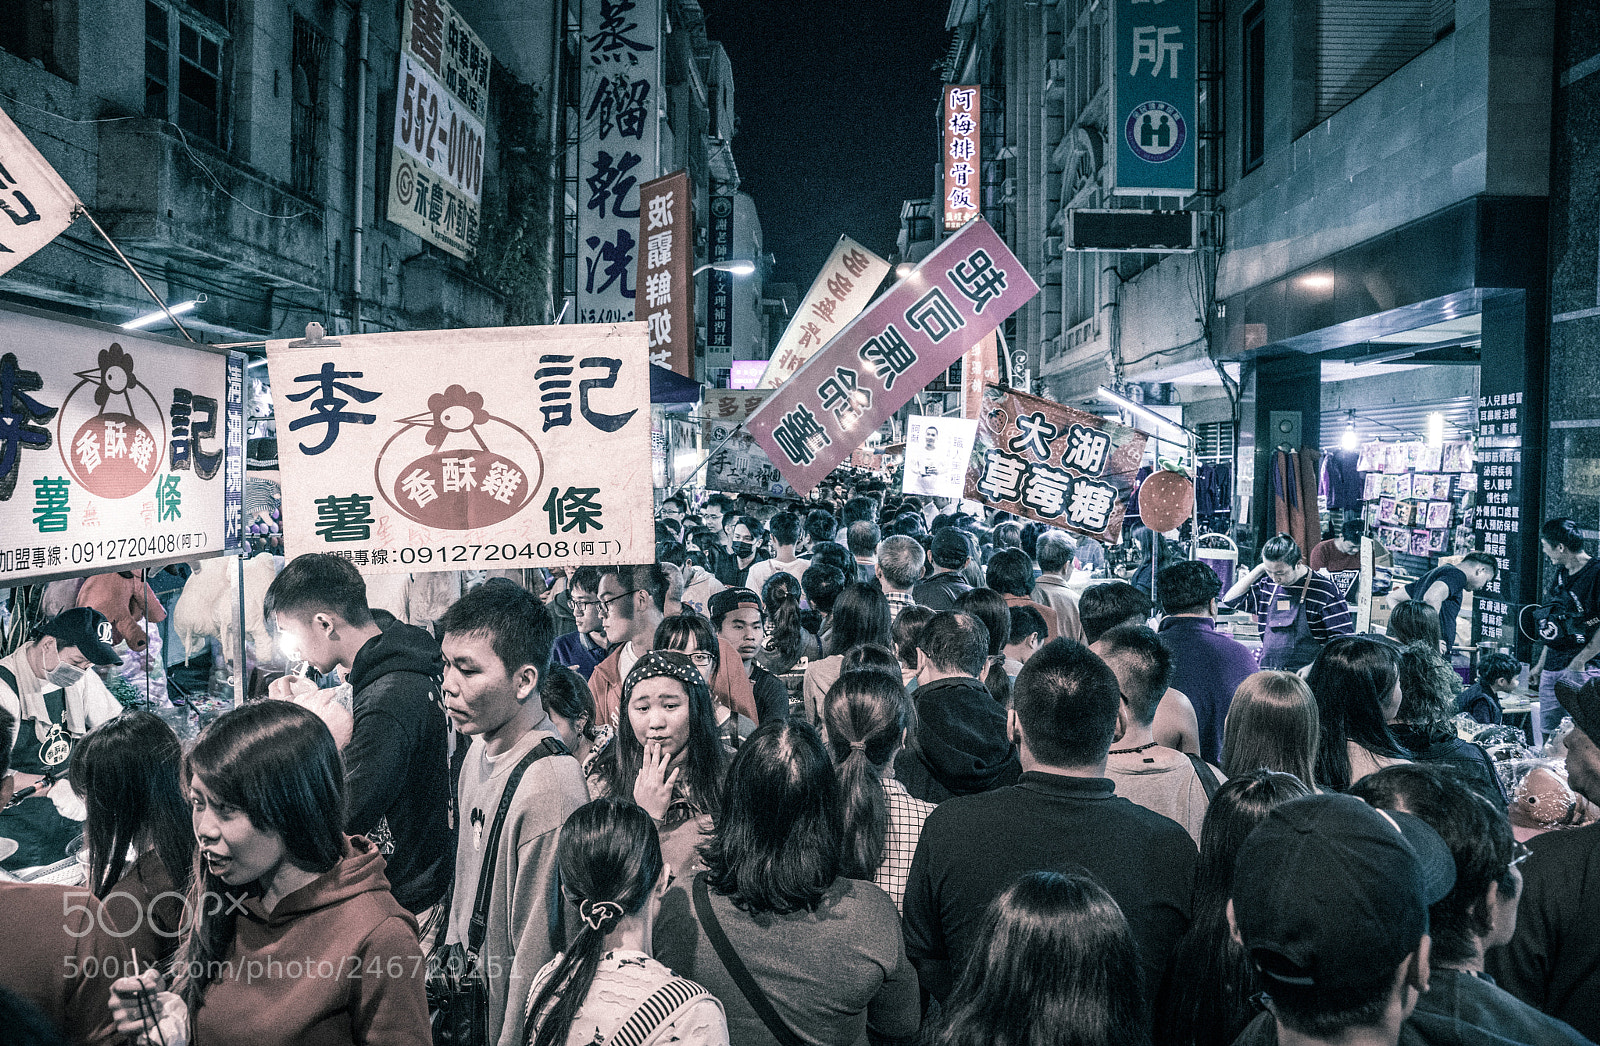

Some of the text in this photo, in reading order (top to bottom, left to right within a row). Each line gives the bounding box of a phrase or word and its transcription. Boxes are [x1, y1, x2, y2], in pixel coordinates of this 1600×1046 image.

[1129, 0, 1184, 79] 所
[401, 72, 483, 196] 552-0006
[947, 87, 978, 210] 阿梅排骨飯
[169, 387, 223, 480] 記
[285, 362, 382, 455] 李
[534, 354, 638, 433] 記
[76, 420, 156, 474] 香酥雞
[1012, 415, 1108, 473] 大湖
[1483, 466, 1513, 477] 泌尿疾病
[32, 474, 182, 533] 薯 條
[401, 457, 522, 509] 香酥雞
[981, 452, 1116, 530] 草莓糖
[1483, 479, 1512, 490] 老人醫學
[1486, 492, 1509, 504] 慢性病
[313, 494, 375, 542] 薯
[542, 486, 603, 536] 條
[1475, 519, 1519, 533] 成人預防保健
